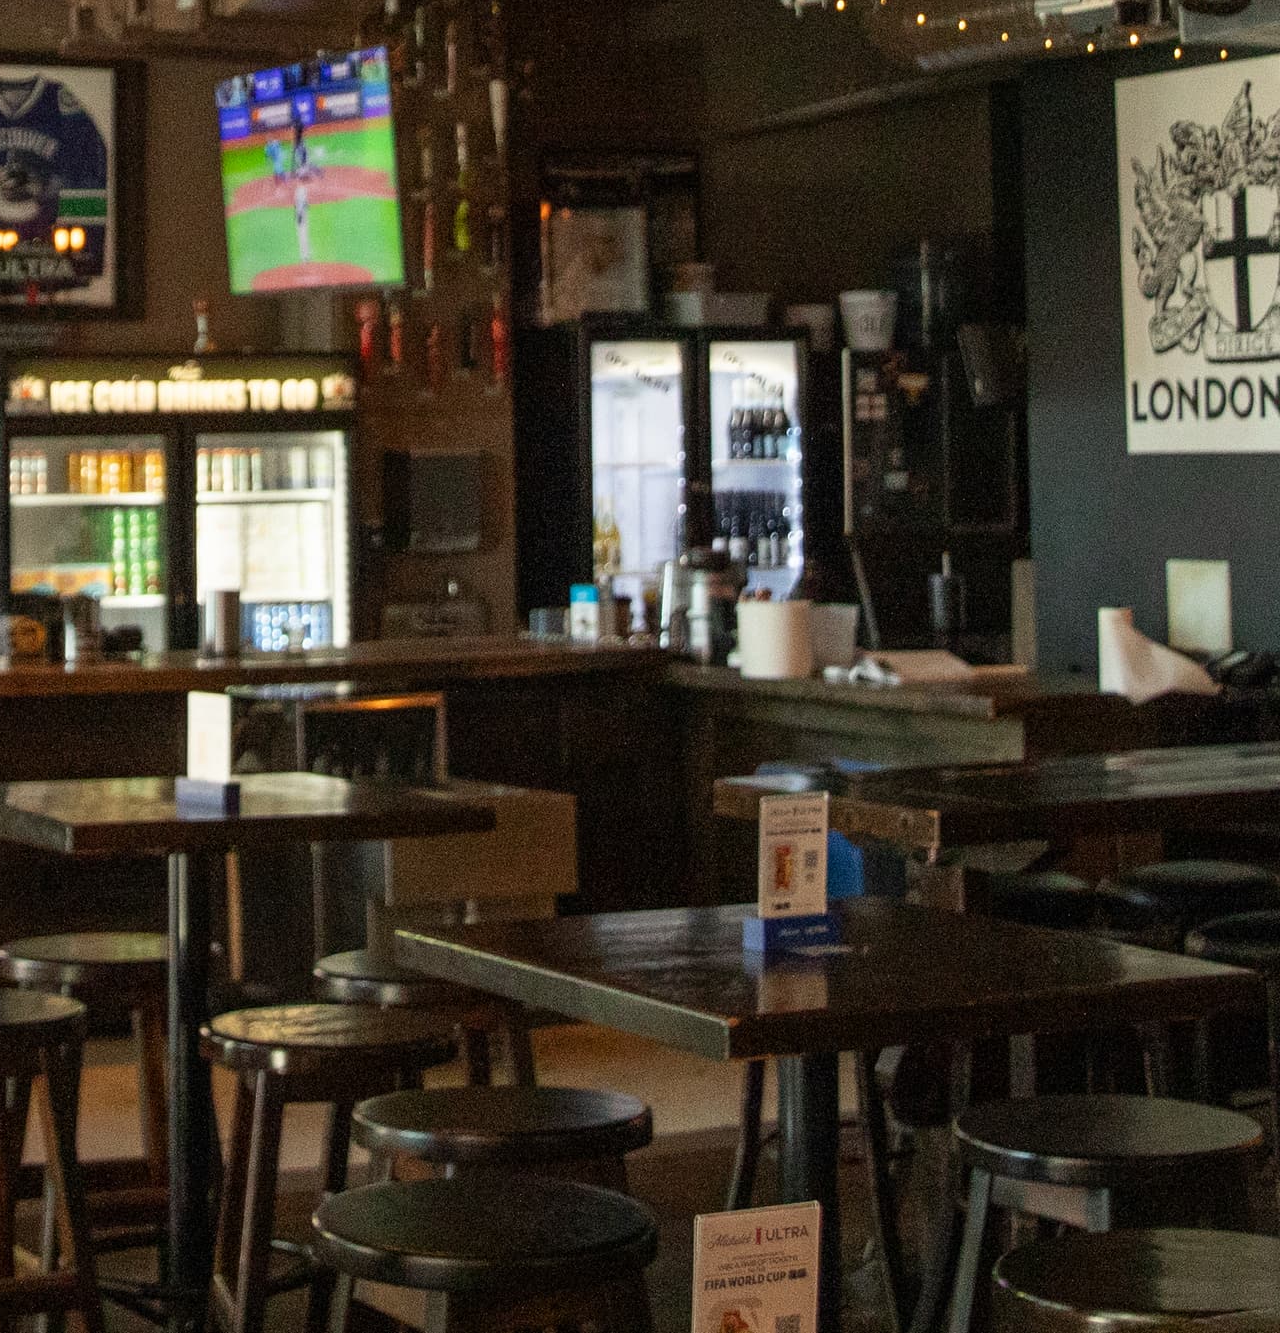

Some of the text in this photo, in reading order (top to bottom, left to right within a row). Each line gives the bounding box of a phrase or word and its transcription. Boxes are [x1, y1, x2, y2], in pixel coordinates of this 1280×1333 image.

[764, 1225, 809, 1241] ULTRA
[704, 1278, 726, 1291] FIFA
[728, 1273, 765, 1288] WORLD
[766, 1270, 787, 1281] CUP
